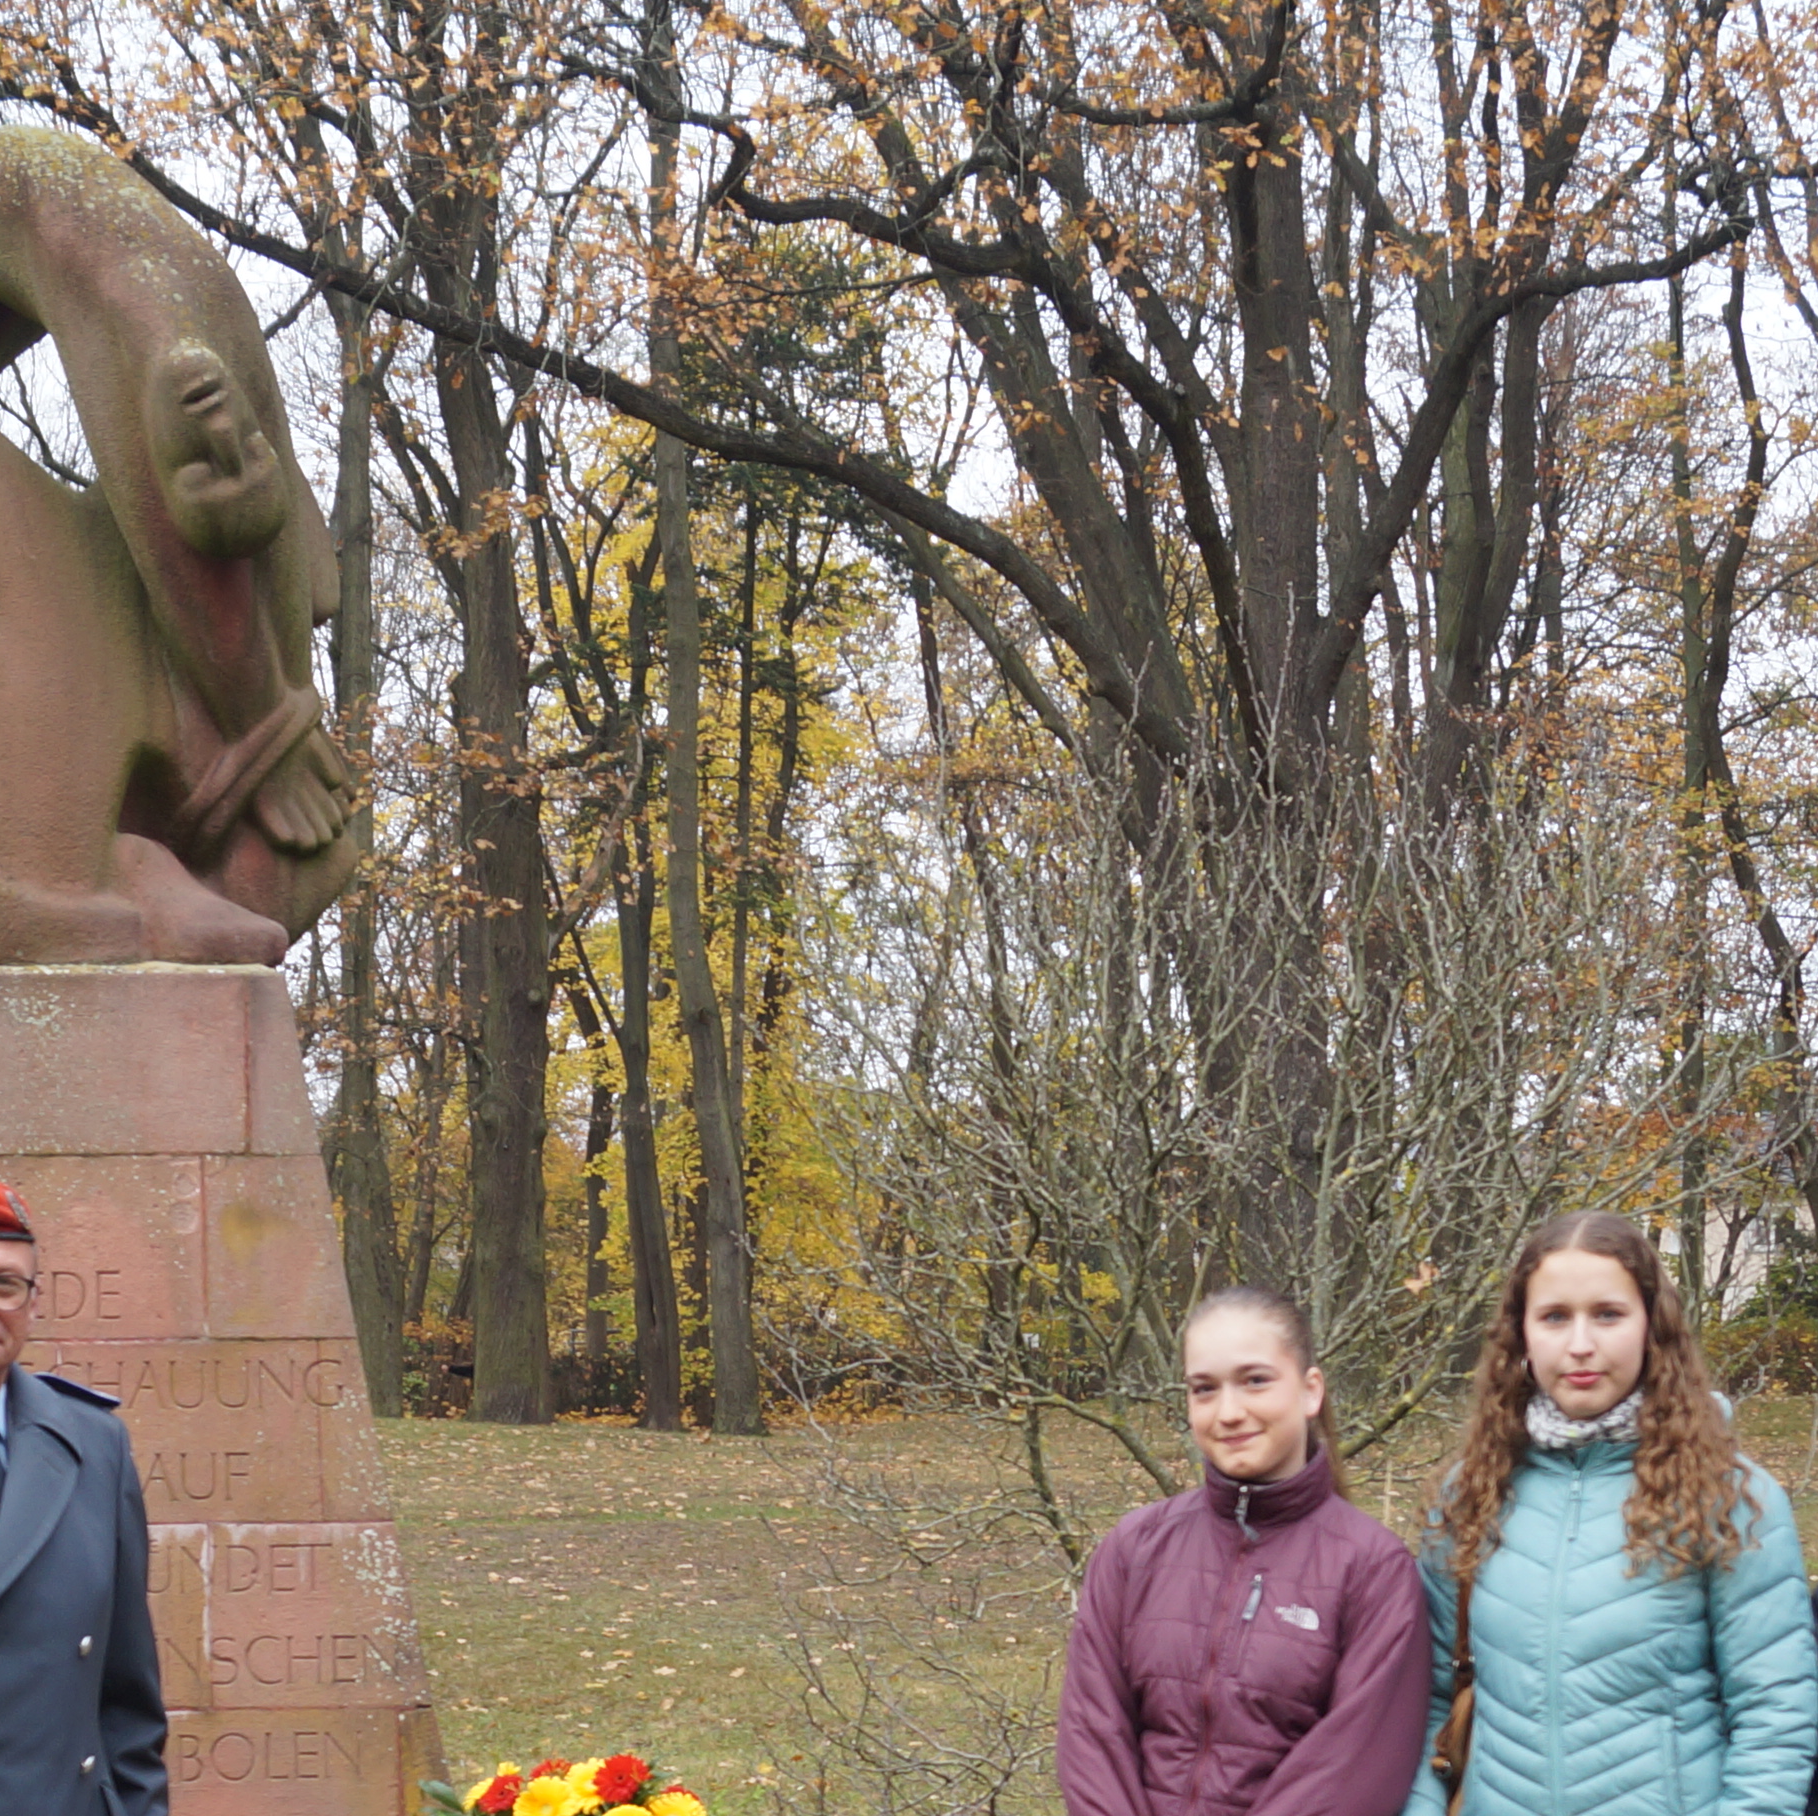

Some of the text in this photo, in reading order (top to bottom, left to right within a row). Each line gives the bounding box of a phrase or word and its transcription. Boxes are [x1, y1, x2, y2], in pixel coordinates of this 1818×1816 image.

[142, 1451, 251, 1501] AUF
[156, 1633, 401, 1686] NSCHEN
[175, 1731, 364, 1783] BOLEN
